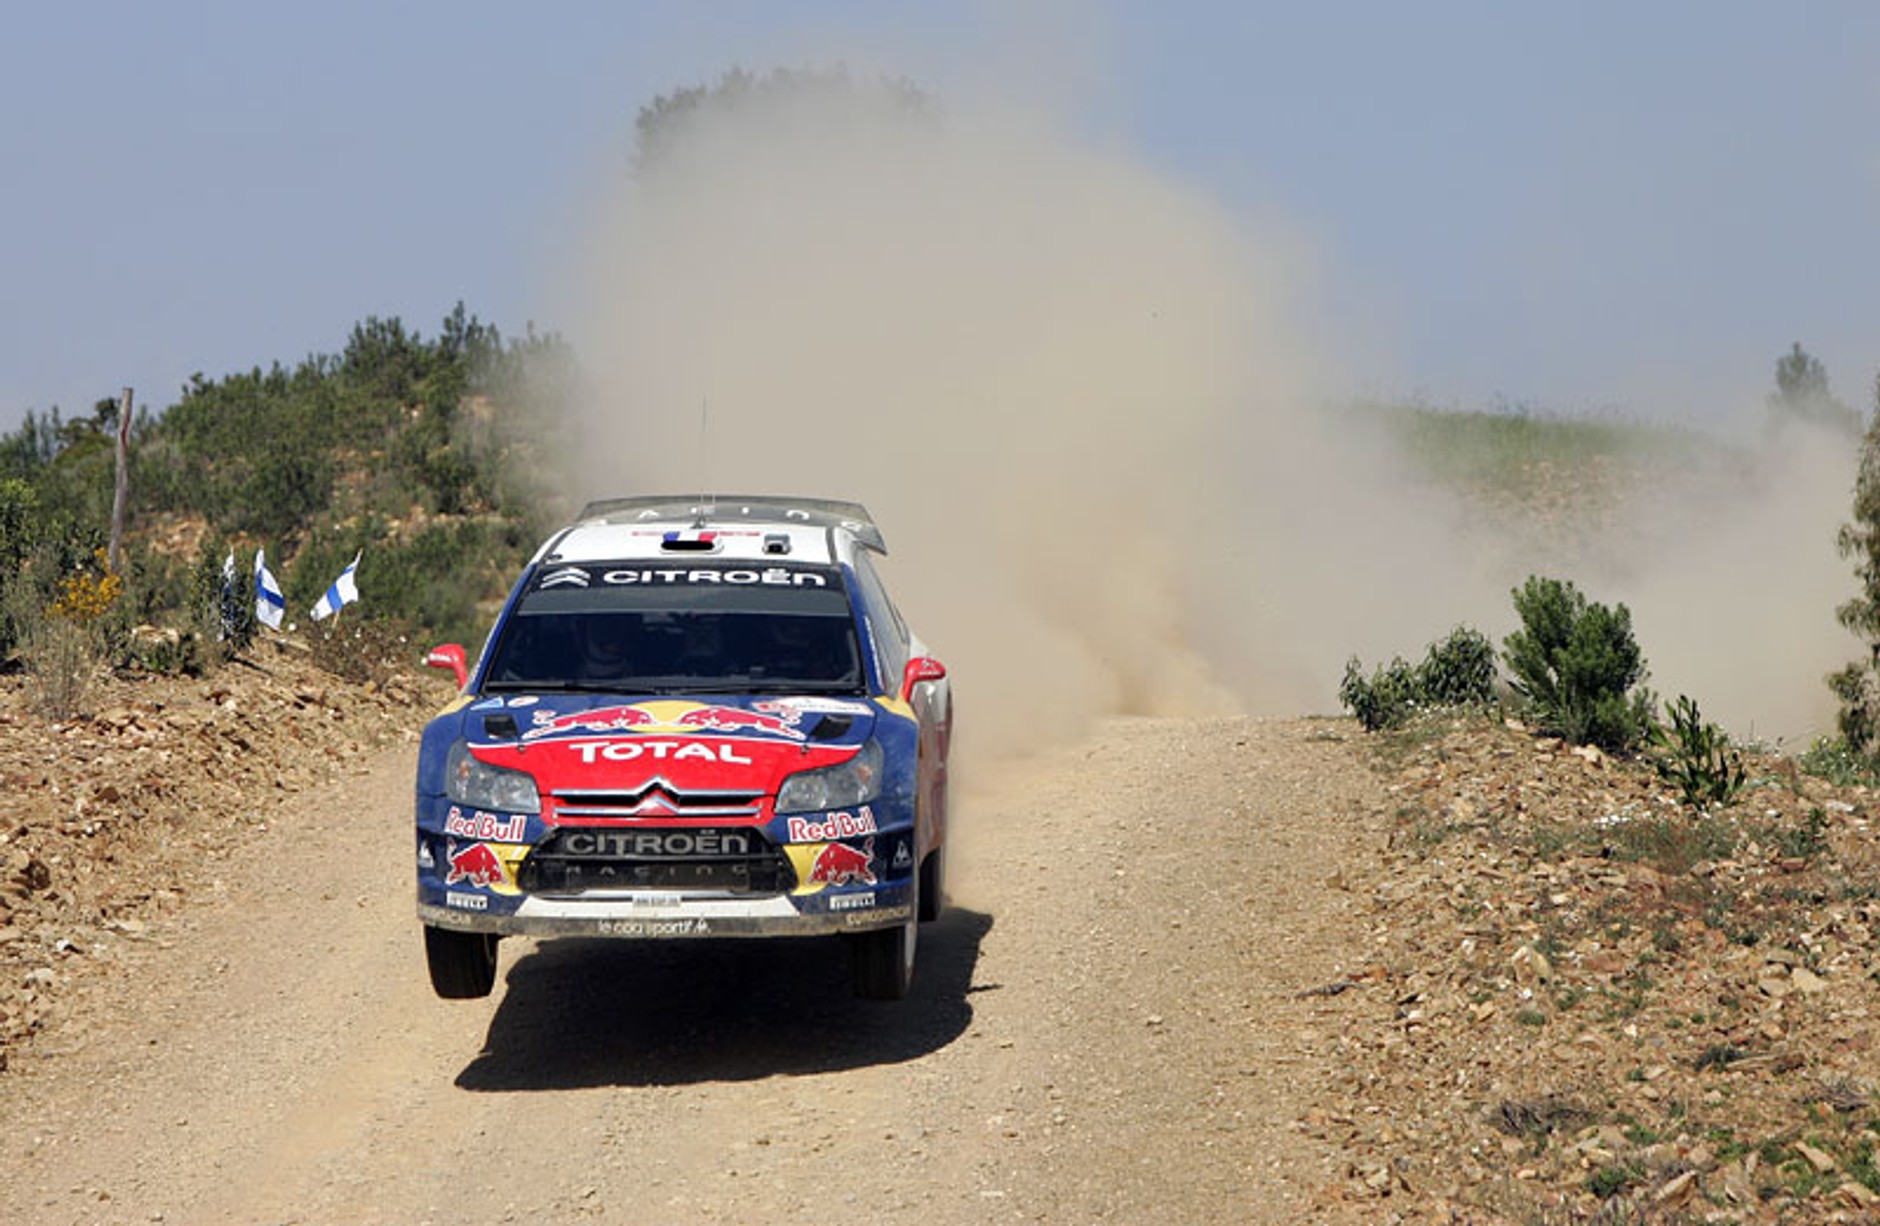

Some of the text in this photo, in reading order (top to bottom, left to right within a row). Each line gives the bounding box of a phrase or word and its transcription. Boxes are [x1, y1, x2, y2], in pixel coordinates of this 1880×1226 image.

[568, 742, 752, 765] TOTAL
[446, 806, 526, 842] Red Bull
[788, 804, 877, 842] Red Bull
